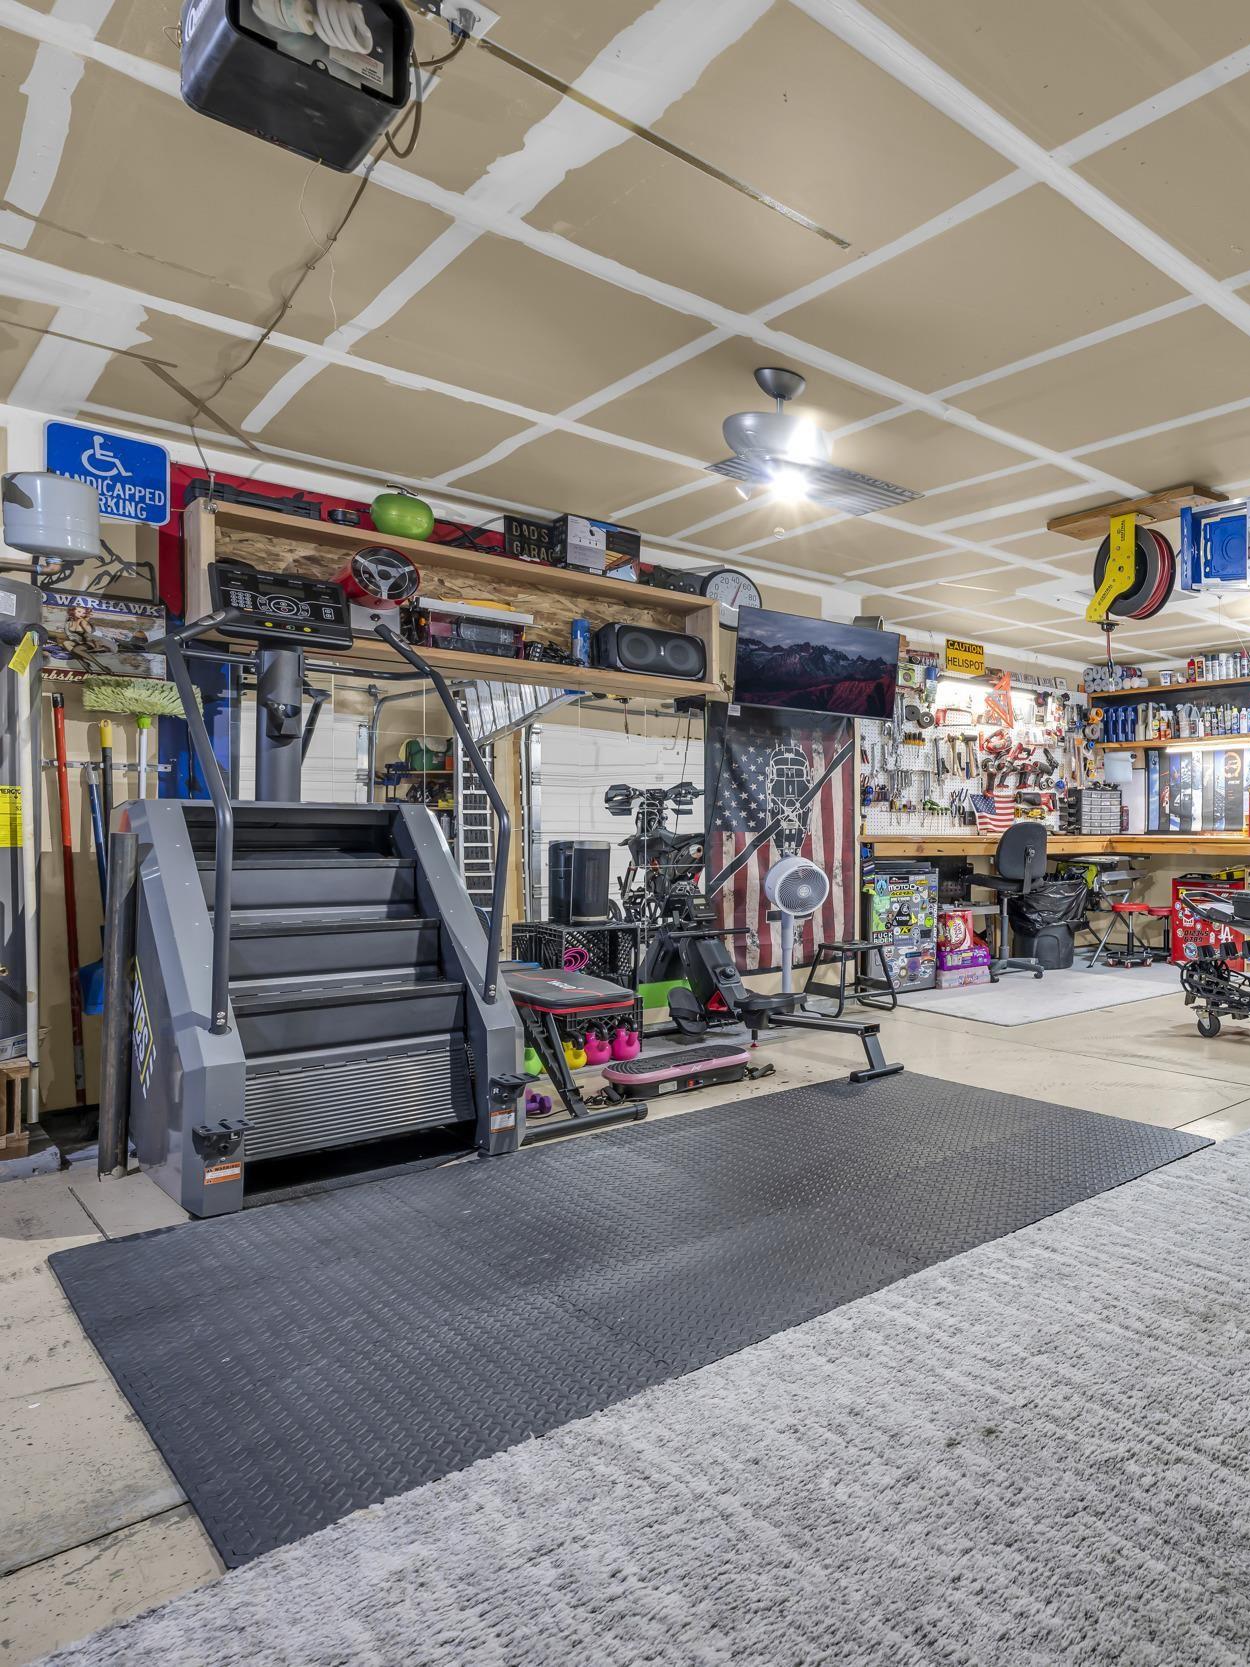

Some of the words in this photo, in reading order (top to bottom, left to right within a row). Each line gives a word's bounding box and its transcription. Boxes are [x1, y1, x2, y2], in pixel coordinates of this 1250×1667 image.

[55, 470, 165, 506] DICAPPED
[98, 495, 147, 519] RKING
[512, 521, 549, 542] DAD'S
[720, 576, 730, 585] 20
[731, 576, 740, 585] 40
[742, 582, 752, 592] 60
[55, 594, 160, 617] WARHAWK
[948, 640, 983, 655] CAUTION
[947, 655, 984, 671] HELISPOT
